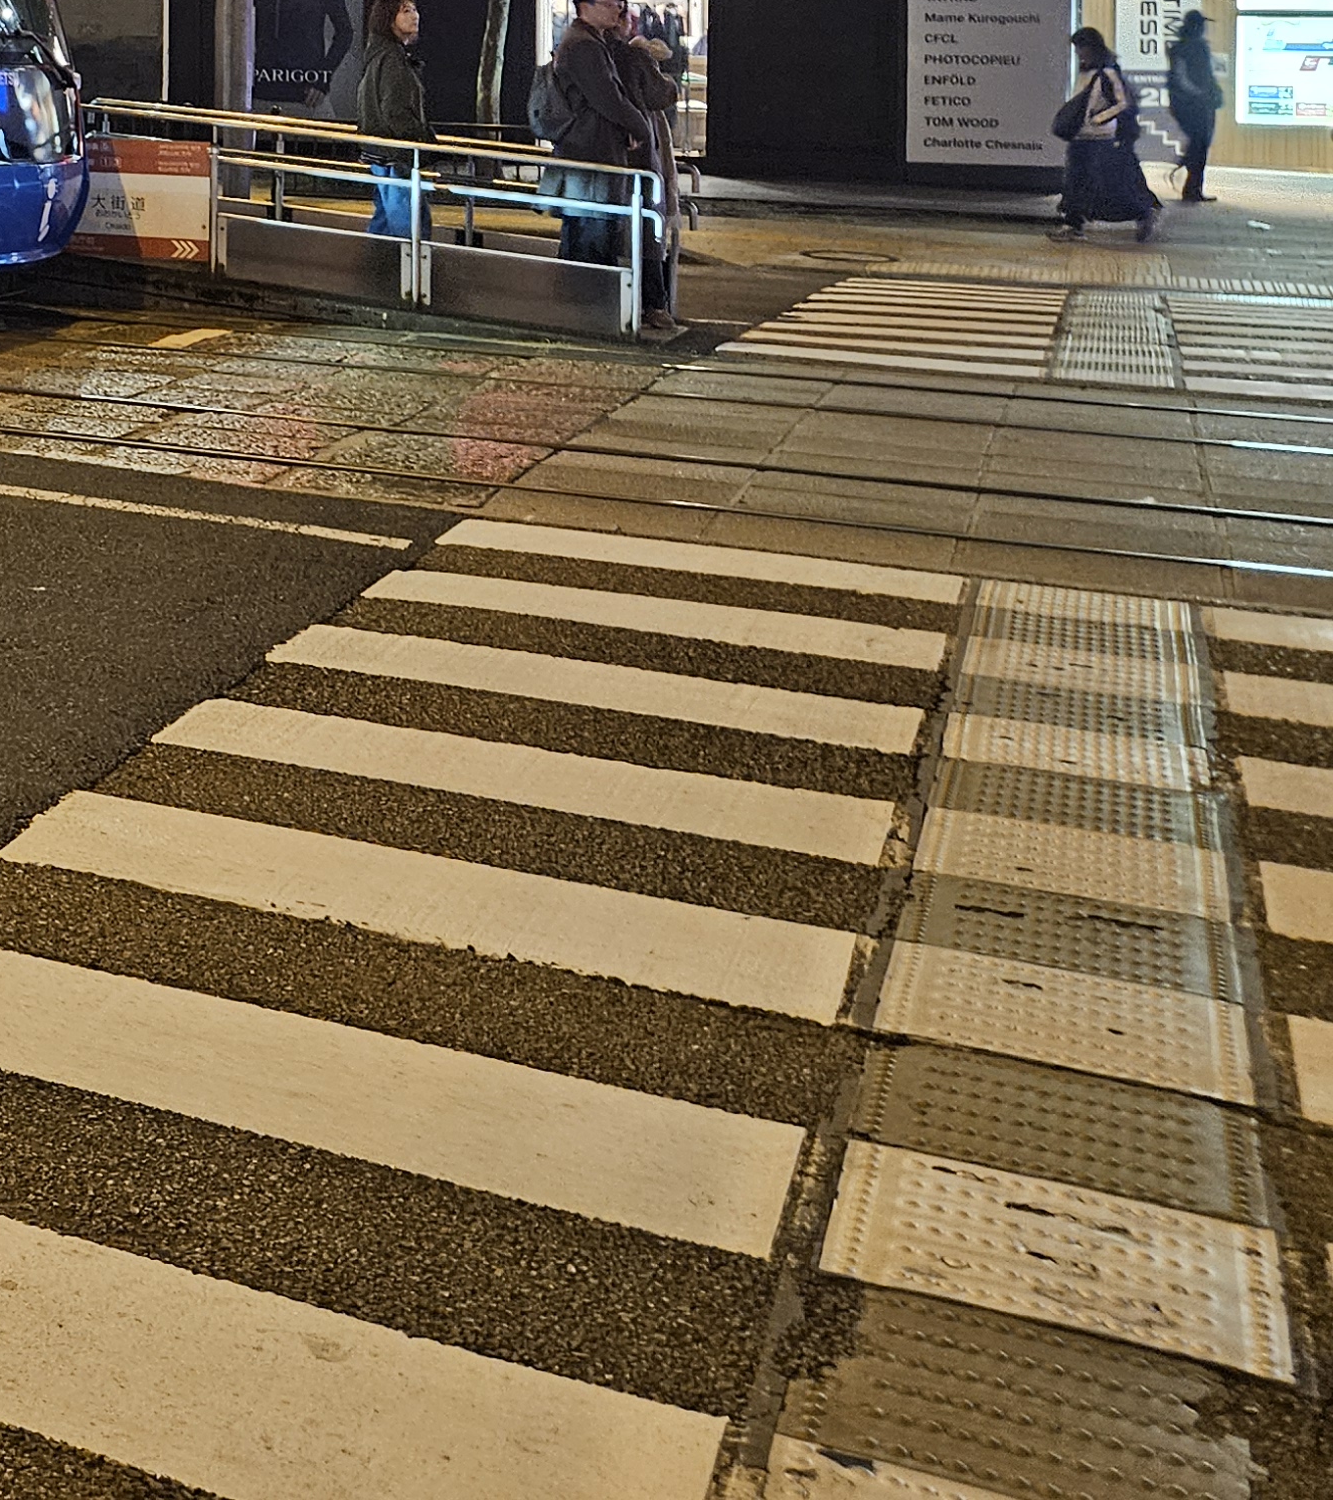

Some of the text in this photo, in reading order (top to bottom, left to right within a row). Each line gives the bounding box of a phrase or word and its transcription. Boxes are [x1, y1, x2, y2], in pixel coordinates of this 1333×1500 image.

[925, 12, 1041, 25] Mame Kurogouchi
[924, 33, 959, 44] CFCL
[924, 73, 976, 86] ENFÖLD
[924, 96, 972, 107] FETICO
[925, 116, 1000, 129] TOM WOOD
[923, 137, 1044, 151] Charlotte Chesnais
[91, 193, 146, 212] 大街道
